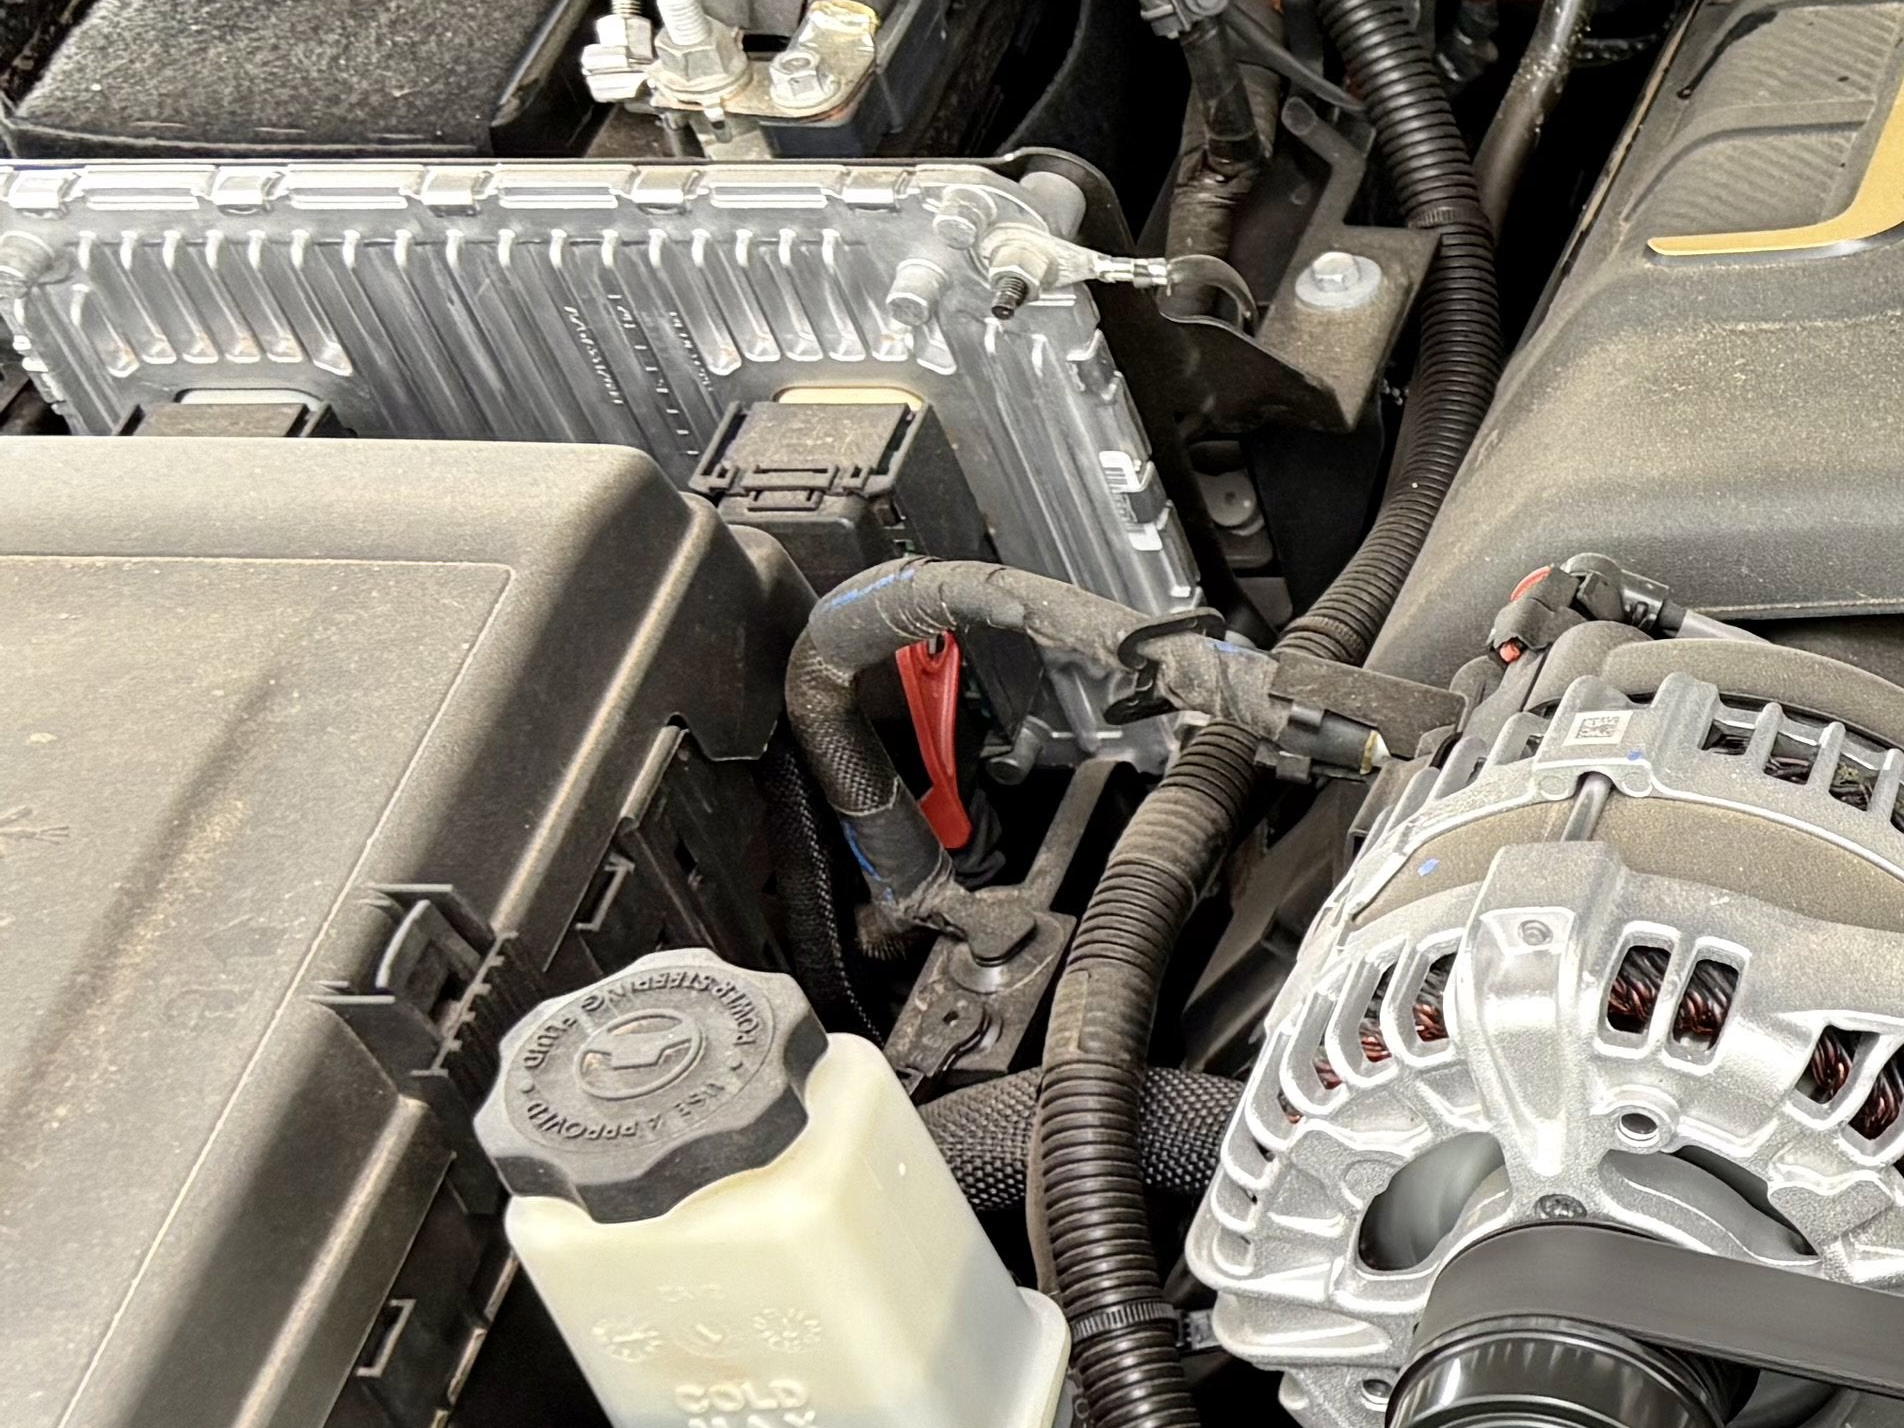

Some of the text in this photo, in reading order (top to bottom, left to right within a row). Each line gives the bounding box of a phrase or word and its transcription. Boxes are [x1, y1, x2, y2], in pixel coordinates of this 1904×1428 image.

[580, 972, 712, 1013] STEERING
[523, 1017, 578, 1071] FLUID
[526, 1082, 725, 1141] USE APPROVED
[674, 1379, 808, 1414] COLD
